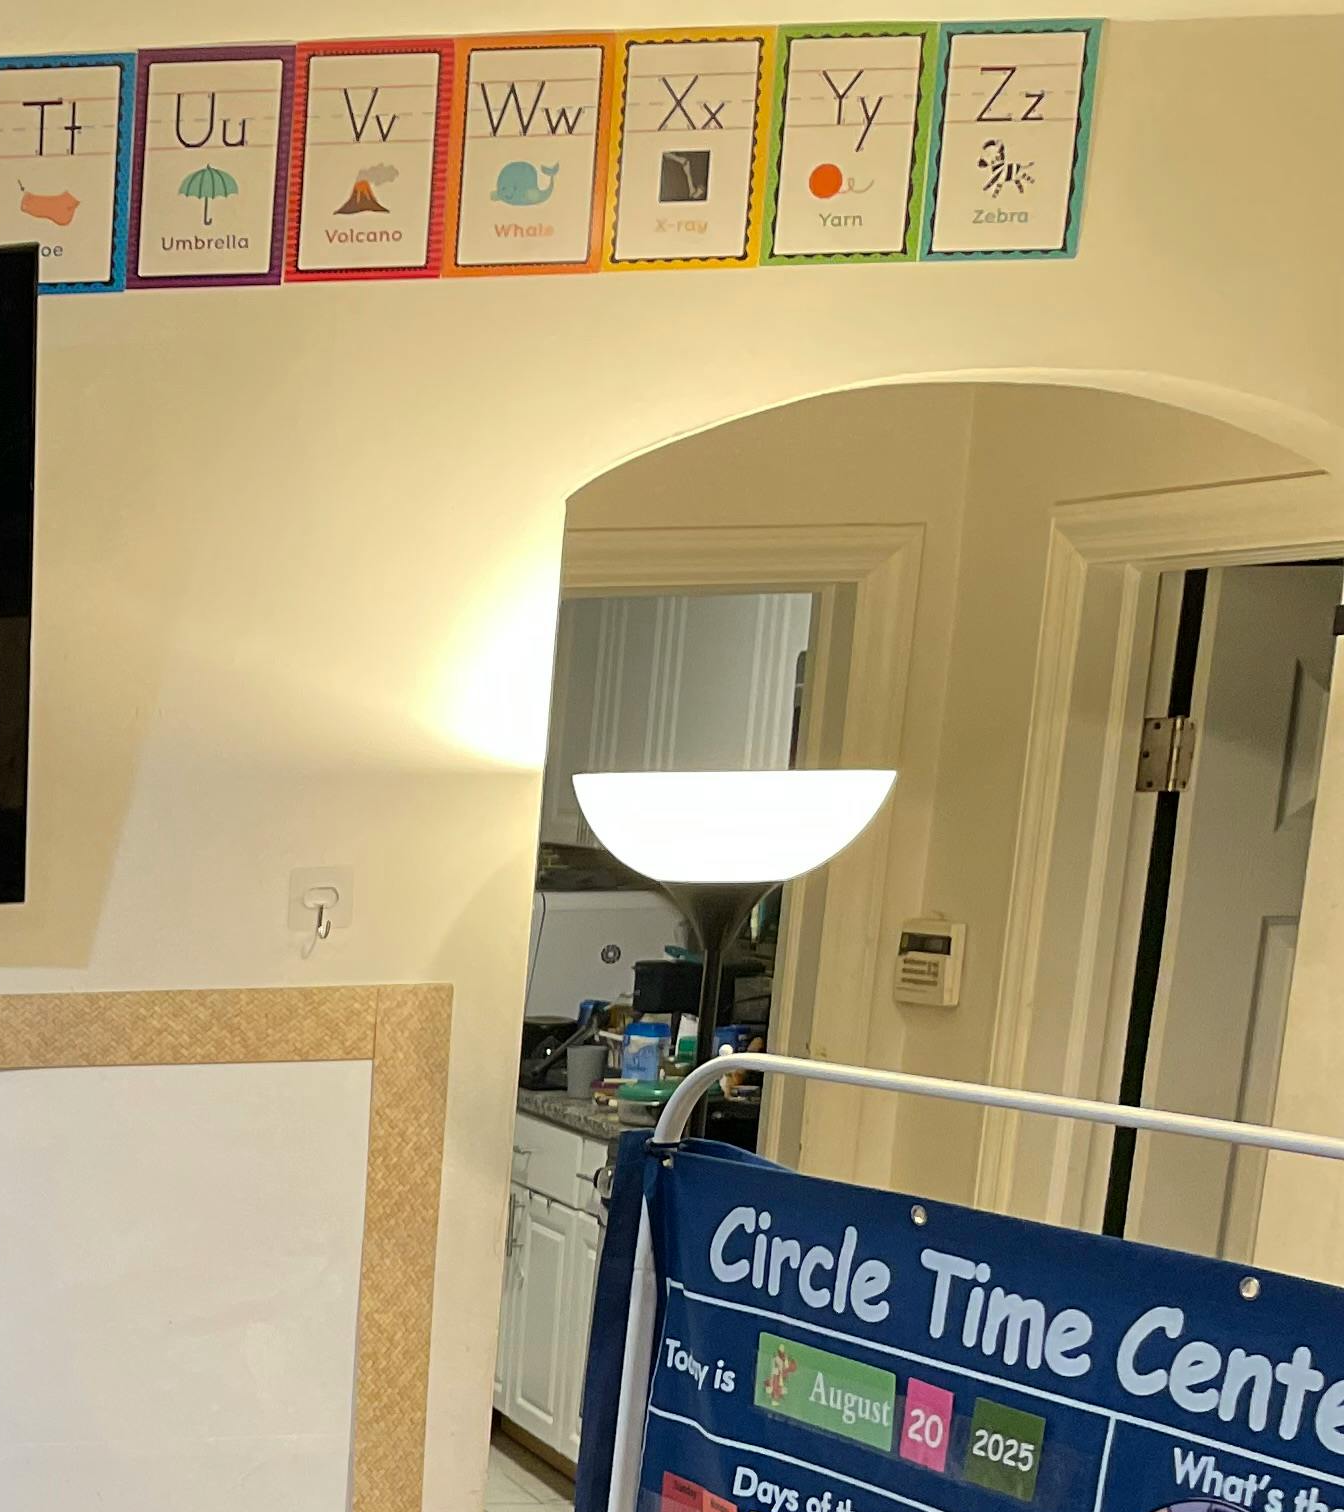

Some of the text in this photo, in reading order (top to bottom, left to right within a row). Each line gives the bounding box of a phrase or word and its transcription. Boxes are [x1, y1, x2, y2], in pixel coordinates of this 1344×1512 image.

[175, 92, 248, 149] Uu
[344, 88, 396, 143] Vv
[480, 81, 583, 137] Ww
[658, 75, 725, 131] Xx
[822, 68, 884, 151] Yy
[977, 66, 1044, 123] Zz
[22, 100, 84, 157] Tt
[162, 232, 249, 253] Umbrella
[324, 226, 402, 244] Volcano
[819, 211, 862, 229] Yarn
[972, 207, 1028, 226] Zebra
[710, 1206, 1343, 1455] Circle Time Cente
[714, 1360, 1034, 1472] is August 20 2025
